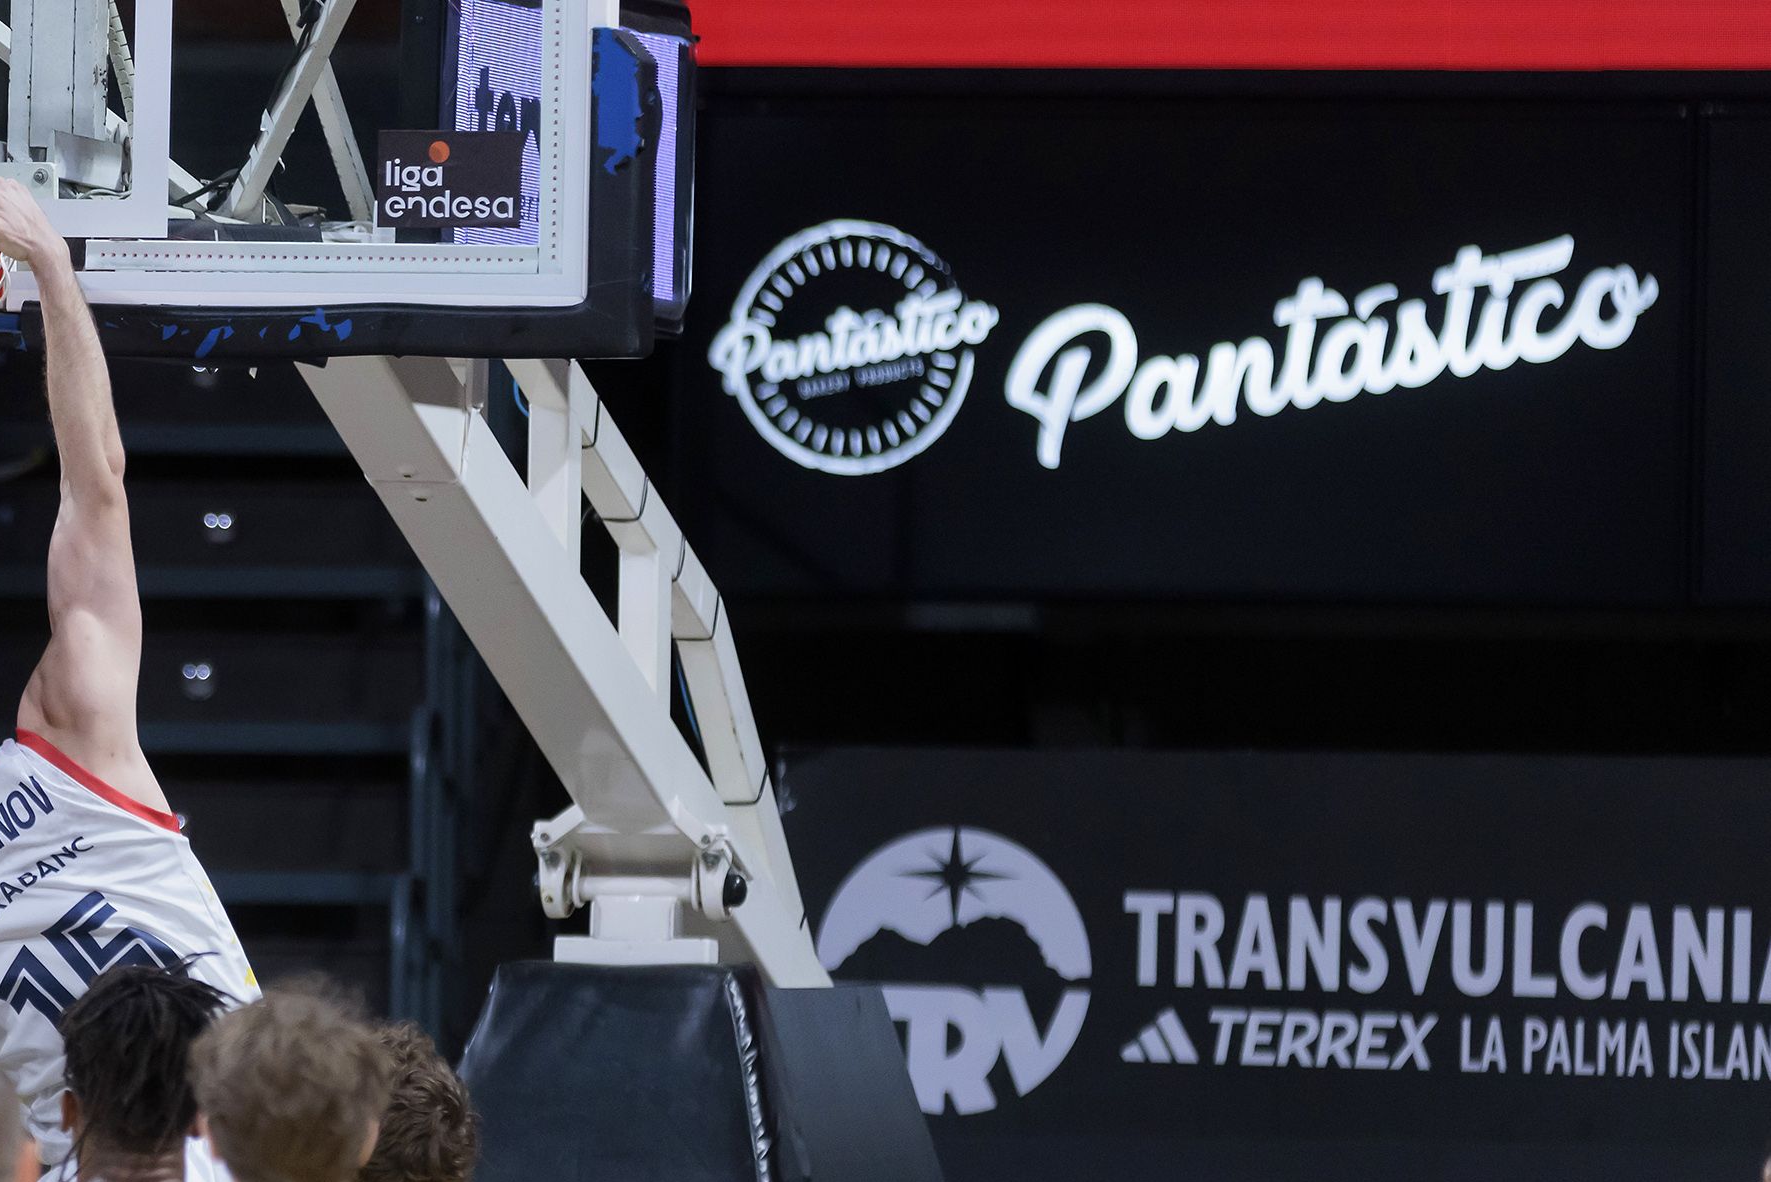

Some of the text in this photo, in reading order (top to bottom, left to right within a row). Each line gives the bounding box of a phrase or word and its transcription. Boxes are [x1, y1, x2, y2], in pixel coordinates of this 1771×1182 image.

[385, 158, 443, 192] liga
[385, 190, 514, 219] endesa
[1003, 233, 1660, 470] Pantástico
[1123, 889, 1771, 1004] TRANSVULCANI
[1209, 1006, 1439, 1071] TERREX
[1459, 1012, 1507, 1074] LA
[1522, 1013, 1655, 1078] PALMA
